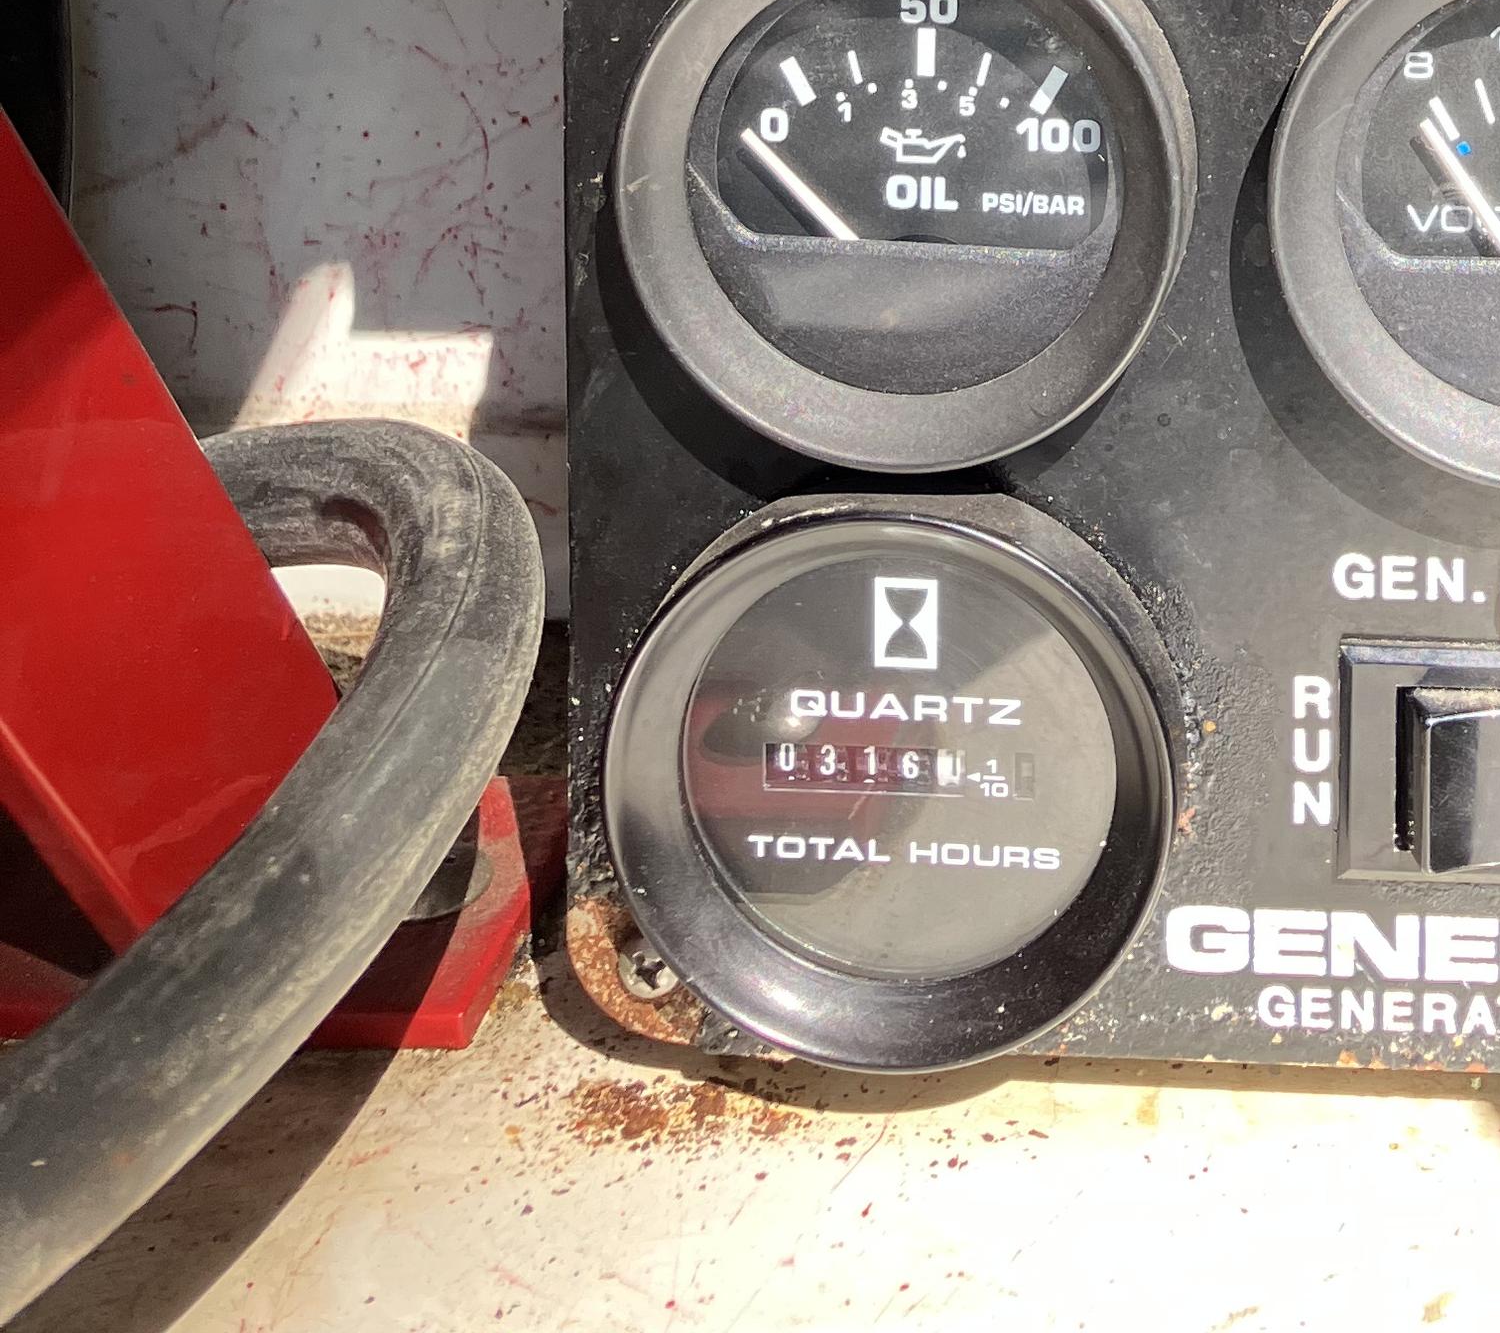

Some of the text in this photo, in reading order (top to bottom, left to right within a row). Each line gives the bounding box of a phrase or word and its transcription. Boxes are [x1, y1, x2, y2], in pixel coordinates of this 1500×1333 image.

[1403, 52, 1433, 80] 8
[838, 102, 851, 122] 1
[901, 89, 918, 109] 3
[959, 97, 976, 116] 5
[760, 108, 788, 142] 0
[1016, 117, 1101, 153] 100
[886, 175, 1086, 217] OIL PSI/BAR
[1333, 553, 1486, 603] GEN.
[790, 688, 1023, 726] QUARTZ
[1293, 675, 1332, 825] RUN
[747, 836, 1062, 870] TOTAL HOURS
